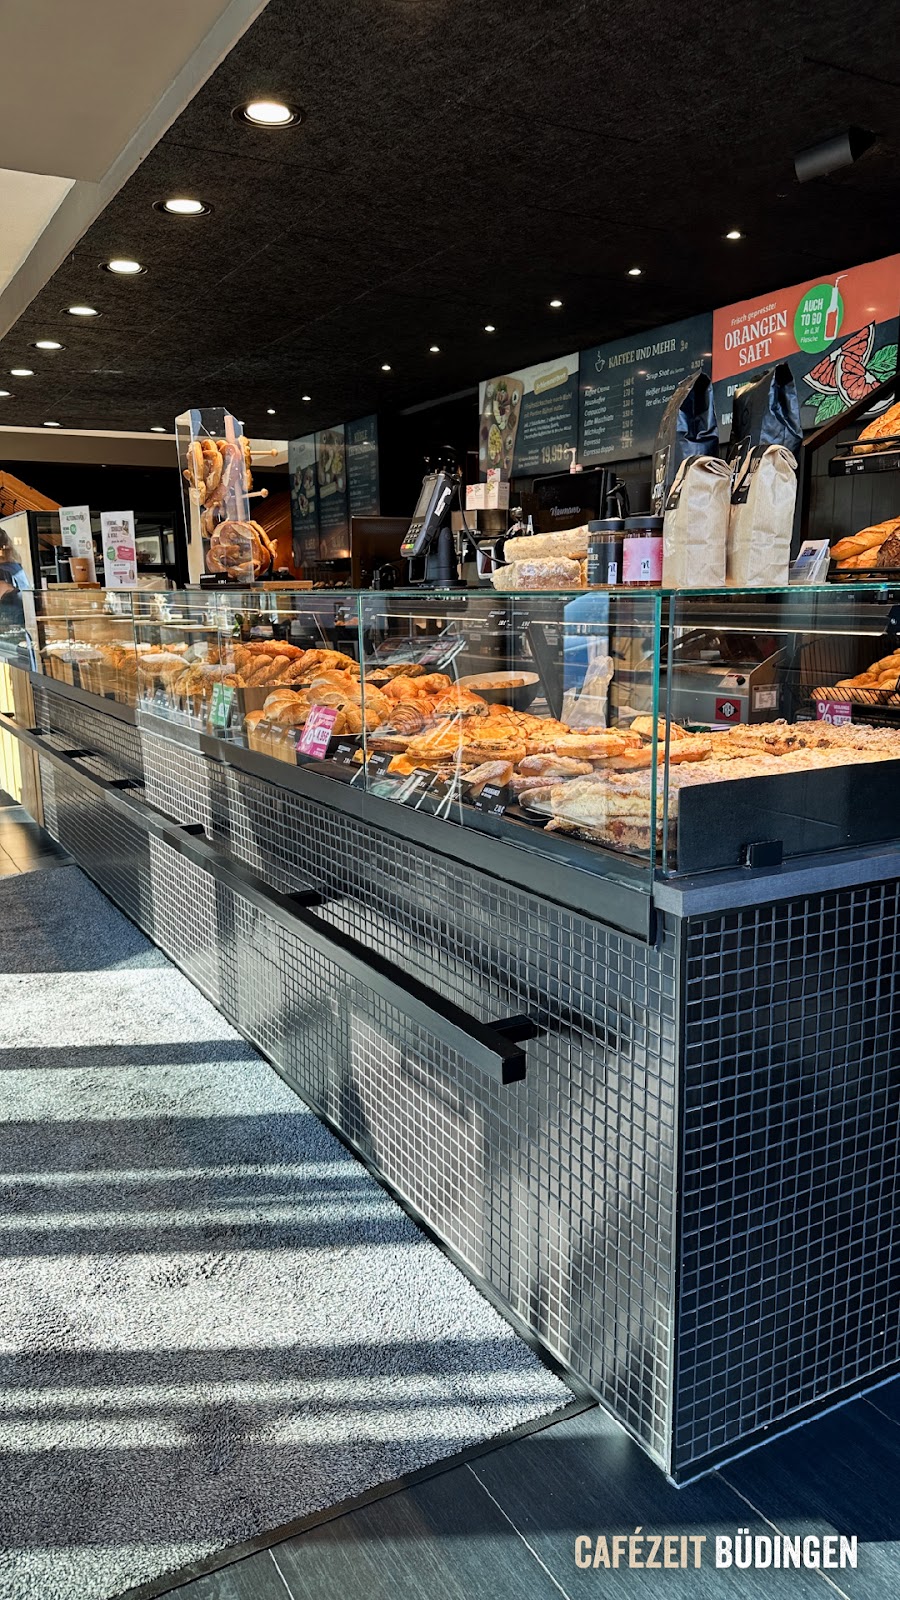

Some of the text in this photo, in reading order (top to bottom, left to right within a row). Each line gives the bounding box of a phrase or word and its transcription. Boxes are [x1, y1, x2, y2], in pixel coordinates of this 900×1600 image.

[731, 302, 777, 326] Frisch gepresster
[803, 298, 823, 312] AUCH
[801, 312, 822, 326] TO GO
[724, 310, 788, 351] ORANGEN
[608, 339, 676, 368] KAFFEE UND MEHR
[739, 337, 772, 366] SAFT
[659, 369, 670, 377] Shot
[584, 407, 607, 416] Cappuccino
